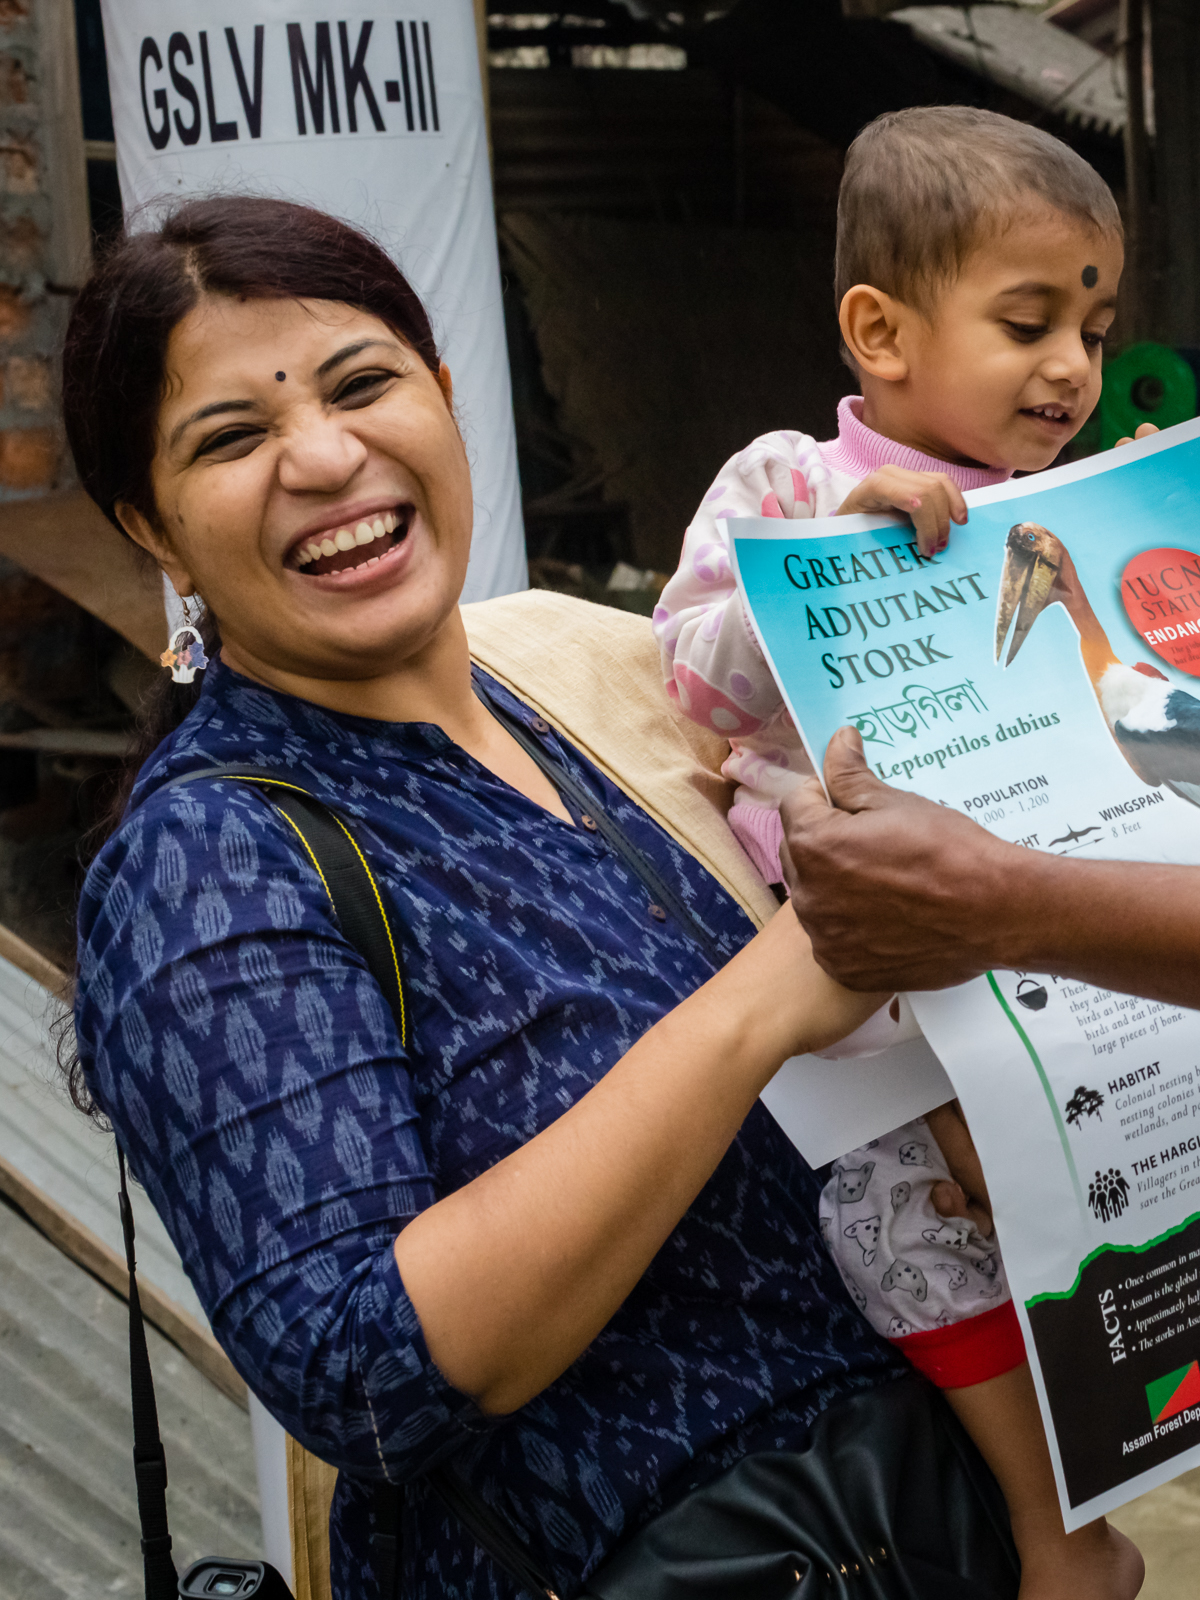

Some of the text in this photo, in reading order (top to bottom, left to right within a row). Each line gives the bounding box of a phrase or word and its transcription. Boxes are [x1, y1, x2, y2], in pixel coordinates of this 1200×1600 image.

[139, 20, 441, 150] GSLV MK-III
[783, 541, 943, 590] GREATER
[805, 572, 989, 641] ADJUTANT
[821, 634, 953, 689] STORK
[873, 712, 1061, 782] Leptoptilos dubius
[963, 774, 1049, 812] POPULATION
[1098, 791, 1165, 822] WINGSPAN
[1110, 821, 1142, 839] 8 Feet
[1069, 990, 1112, 1013] they also
[1075, 997, 1139, 1027] birds as large
[1083, 1023, 1110, 1041] birds
[1111, 1013, 1130, 1030] and
[1131, 1010, 1146, 1022] eat
[1147, 1002, 1166, 1016] lots
[1091, 1012, 1186, 1056] large pieces of bone.
[1107, 1061, 1161, 1095] HABITAT
[1114, 1083, 1156, 1111] Colonial
[1160, 1072, 1194, 1094] nesting
[1119, 1105, 1155, 1127] nesting
[1157, 1088, 1195, 1111] colonies
[1124, 1115, 1169, 1142] wetlands,
[1170, 1103, 1189, 1122] and
[1130, 1154, 1158, 1176] THE
[1136, 1170, 1177, 1193] Villagers
[1180, 1164, 1190, 1175] in
[1140, 1195, 1159, 1210] save
[1161, 1186, 1176, 1200] the
[1124, 1274, 1145, 1290] Once
[1145, 1260, 1177, 1281] common
[1178, 1255, 1187, 1265] in
[1129, 1294, 1153, 1311] Assam
[1154, 1289, 1161, 1299] is
[1161, 1282, 1174, 1296] the
[1175, 1268, 1198, 1294] global
[1098, 1288, 1127, 1365] FACTS
[1134, 1298, 1185, 1334] Approximately
[1138, 1337, 1154, 1352] The
[1154, 1326, 1176, 1344] storks
[1176, 1323, 1185, 1334] in
[1122, 1432, 1153, 1456] Assam
[1153, 1414, 1183, 1439] Forest
